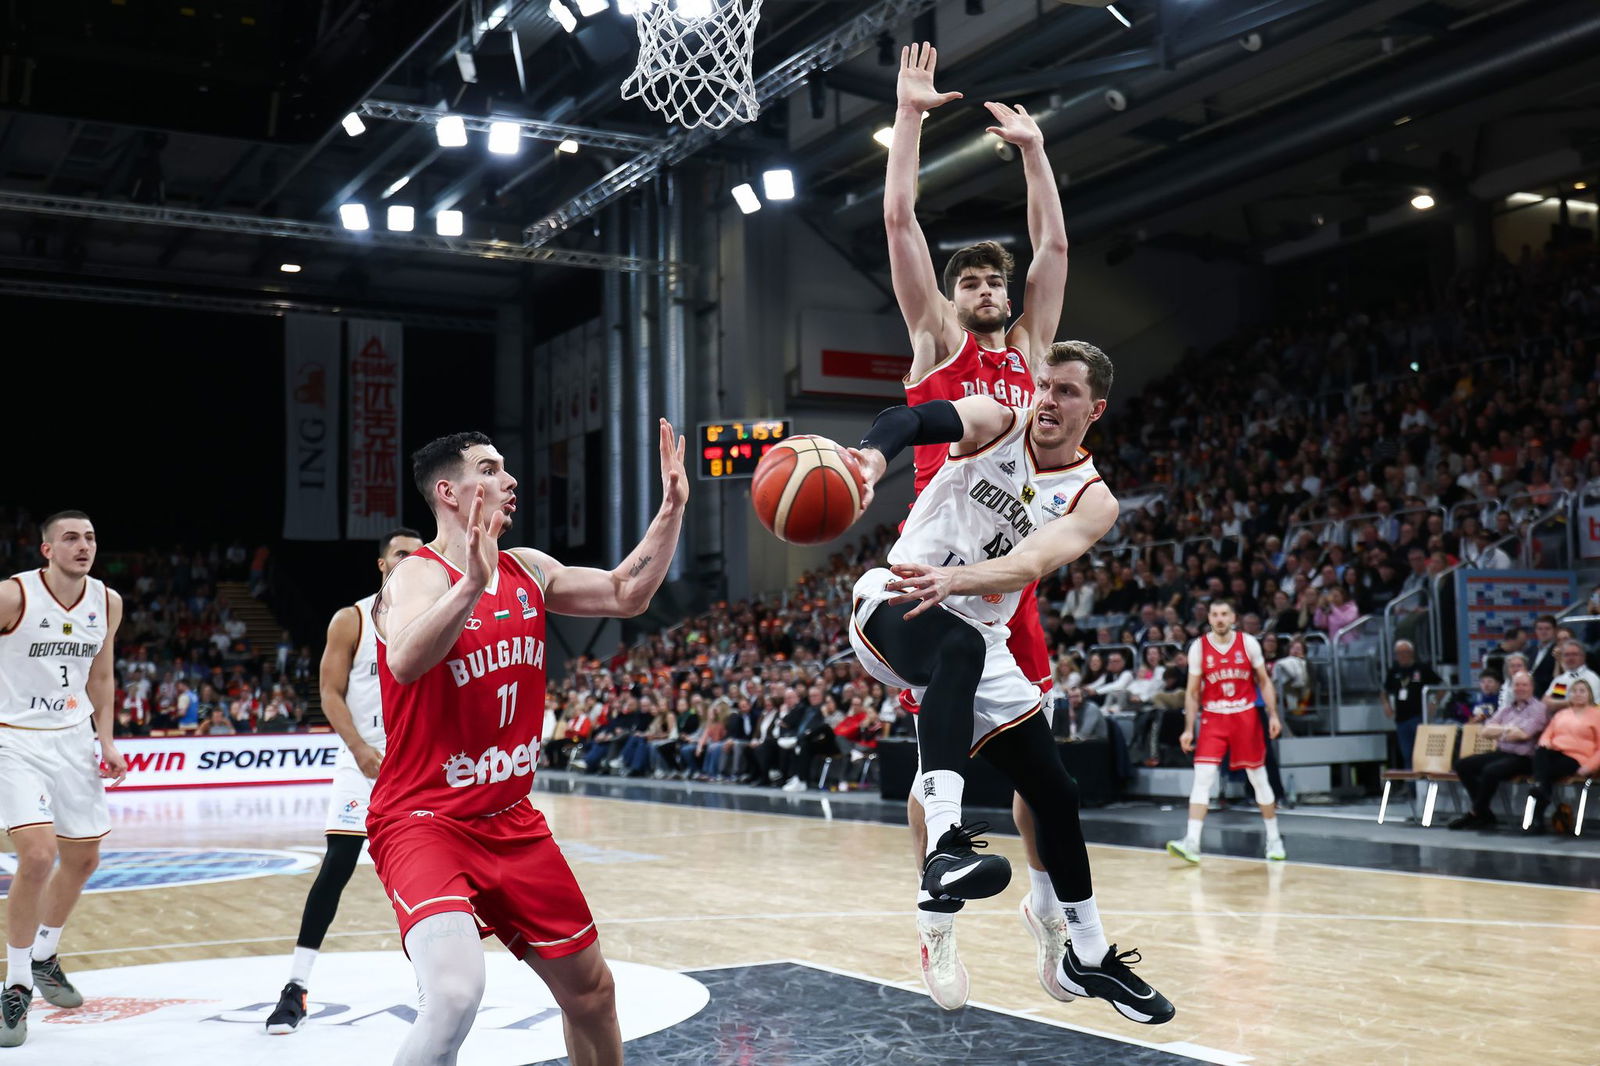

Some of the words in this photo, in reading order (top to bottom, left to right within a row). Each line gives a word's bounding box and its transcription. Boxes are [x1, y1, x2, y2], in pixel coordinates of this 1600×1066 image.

[961, 378, 1033, 409] BLGRI
[298, 418, 327, 490] ING
[364, 383, 397, 518] 匹克体育
[969, 478, 1037, 538] DEUTSCH
[59, 665, 69, 688] 3
[29, 696, 65, 711] ING
[497, 681, 518, 729] 11
[197, 747, 339, 770] SPORTWE
[446, 736, 540, 788] efbet
